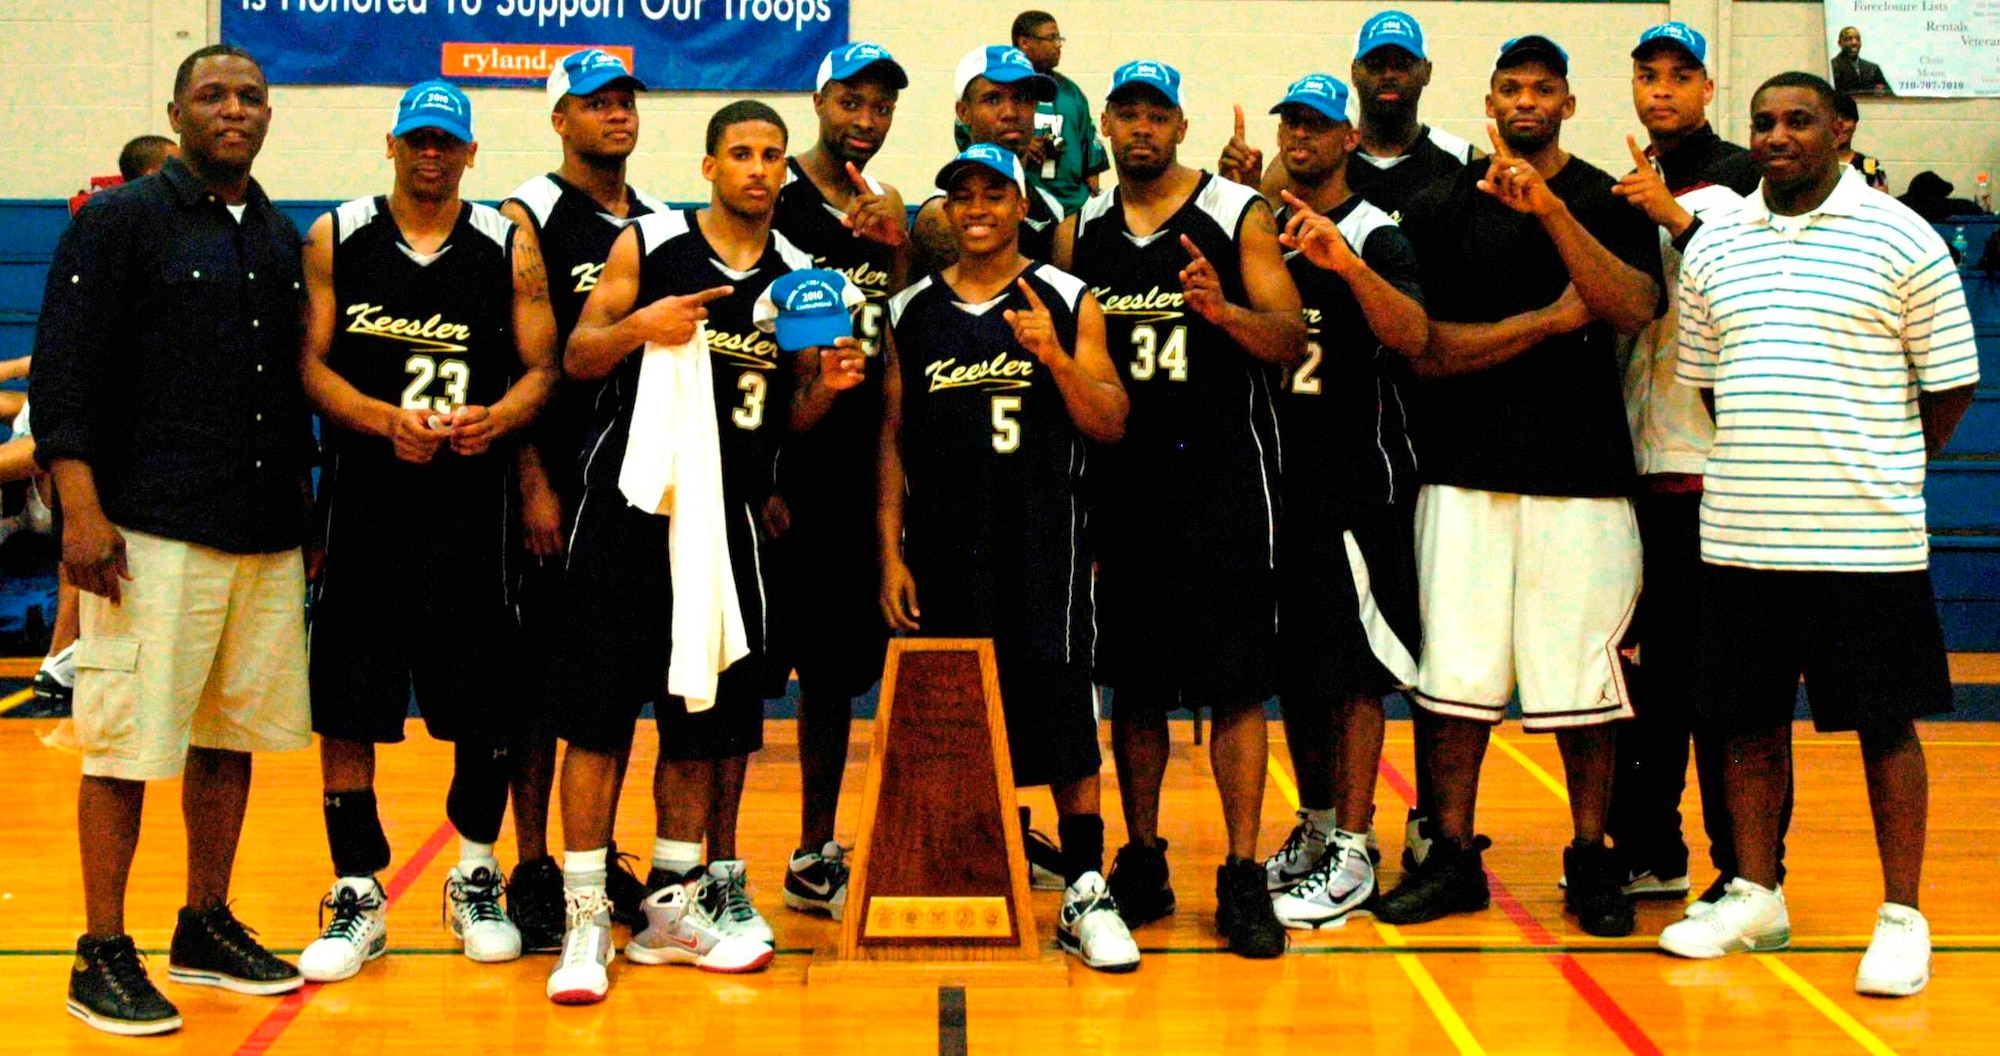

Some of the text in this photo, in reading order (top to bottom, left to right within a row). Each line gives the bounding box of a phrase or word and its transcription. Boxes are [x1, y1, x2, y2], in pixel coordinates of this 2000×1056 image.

[496, 0, 624, 27] Support
[640, 0, 701, 20] Our
[725, 0, 831, 31] Troops
[1854, 1, 1948, 12] Foreclosure Lists
[1926, 20, 1968, 32] Rentals
[802, 290, 823, 303] 2010
[346, 303, 470, 340] Keesler
[701, 319, 778, 358] eesler
[925, 351, 1033, 392] Keesler
[1130, 325, 1188, 381] 34
[1291, 341, 1323, 395] 2
[401, 354, 470, 415] 23
[732, 371, 768, 430] 3
[991, 395, 1022, 453] 5
